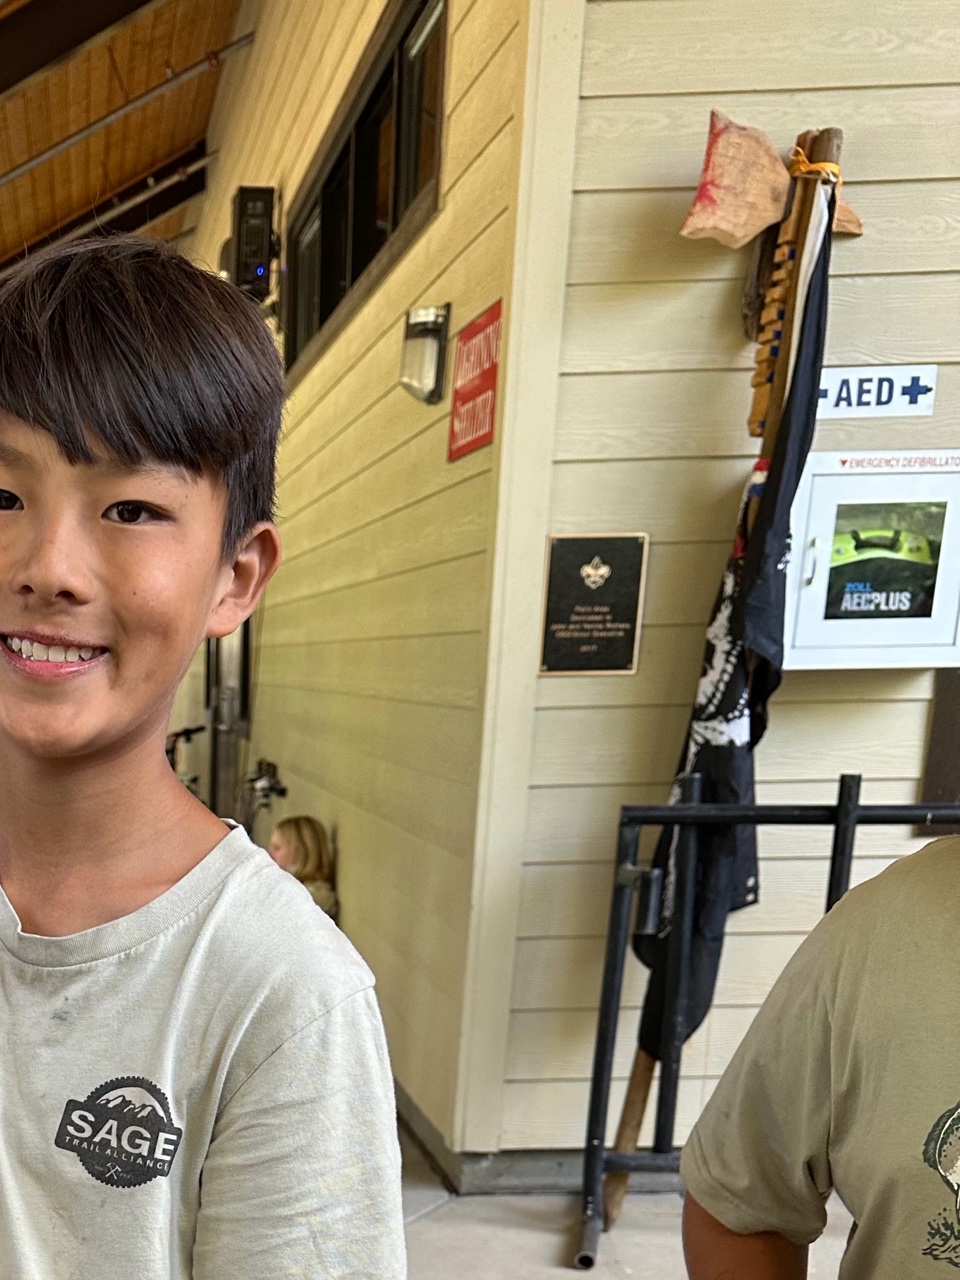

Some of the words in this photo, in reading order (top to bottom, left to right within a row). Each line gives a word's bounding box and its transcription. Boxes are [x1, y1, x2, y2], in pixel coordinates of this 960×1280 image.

[833, 376, 895, 407] AED
[848, 457, 900, 469] EMERGENCY
[65, 1136, 100, 1153] TRAIL
[66, 1109, 178, 1161] SAGE
